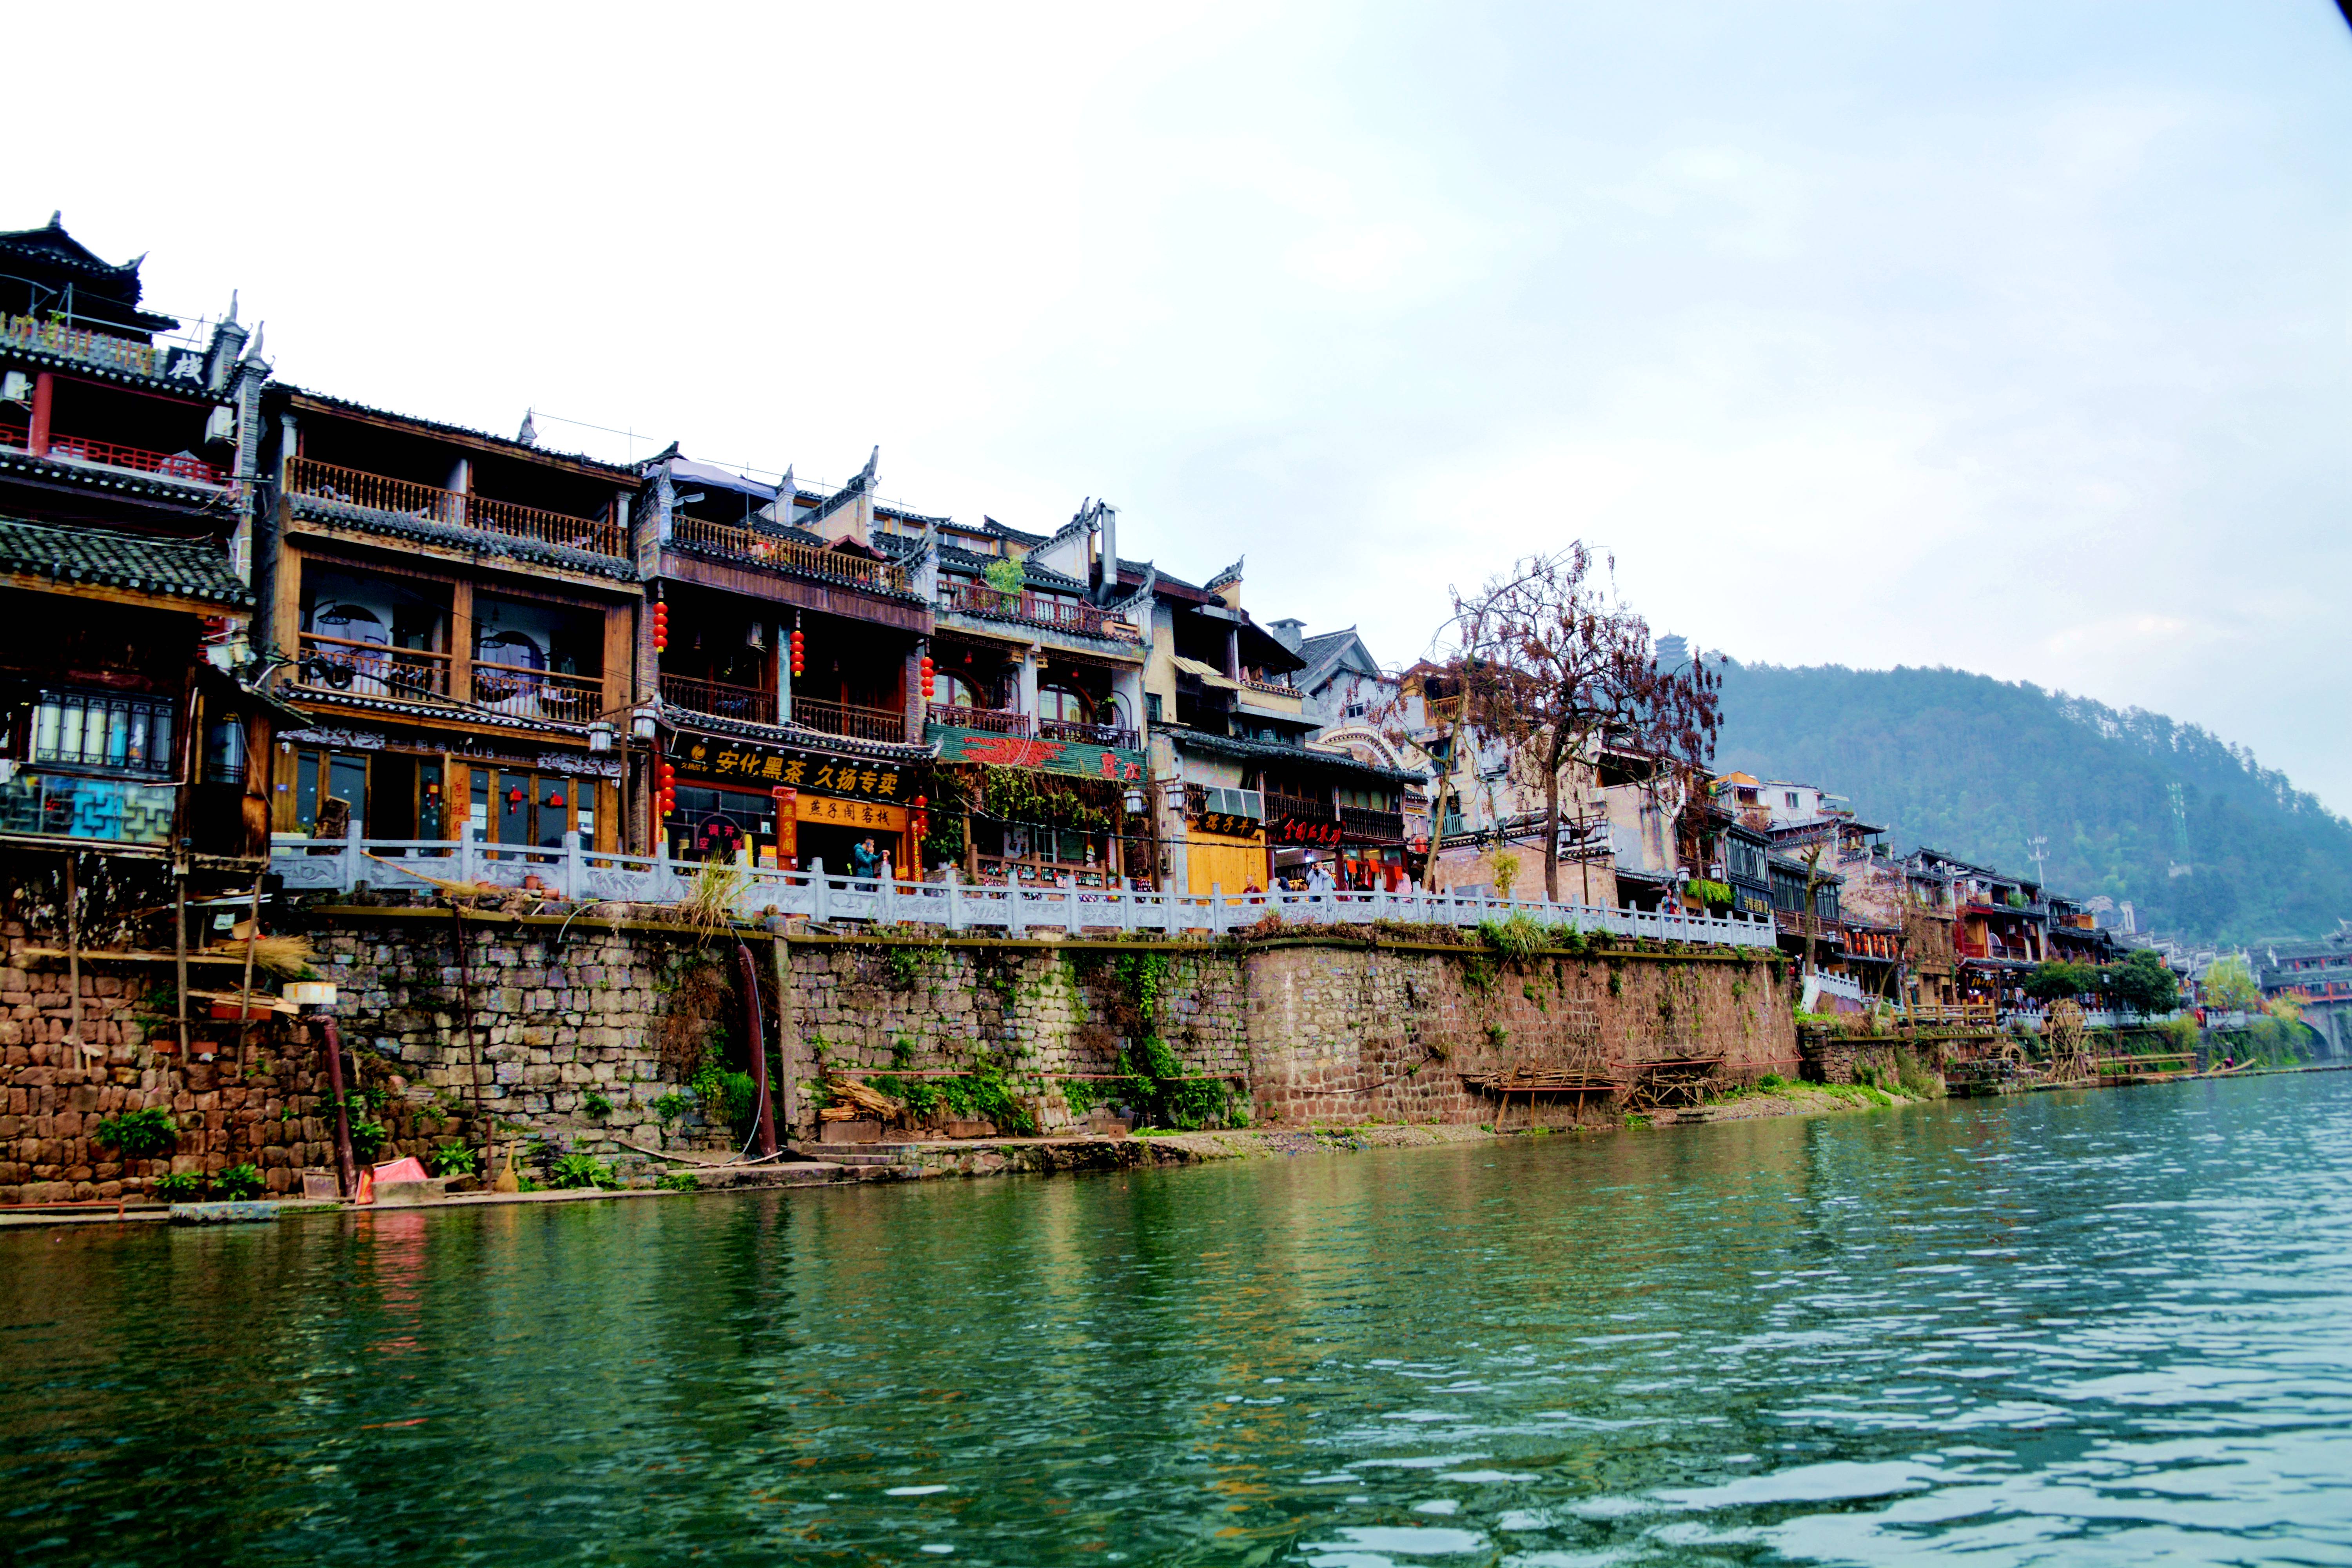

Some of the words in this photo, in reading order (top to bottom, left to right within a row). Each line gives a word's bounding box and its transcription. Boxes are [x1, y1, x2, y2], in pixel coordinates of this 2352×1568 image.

[167, 352, 204, 385] 栈
[715, 750, 807, 784] 安化黑茶
[814, 764, 898, 796] 久扬专卖
[1098, 752, 1141, 780] 喜欢
[809, 799, 890, 826] 燕子阁客栈
[699, 824, 742, 850] 空调开放
[782, 804, 795, 854] 燕子阁
